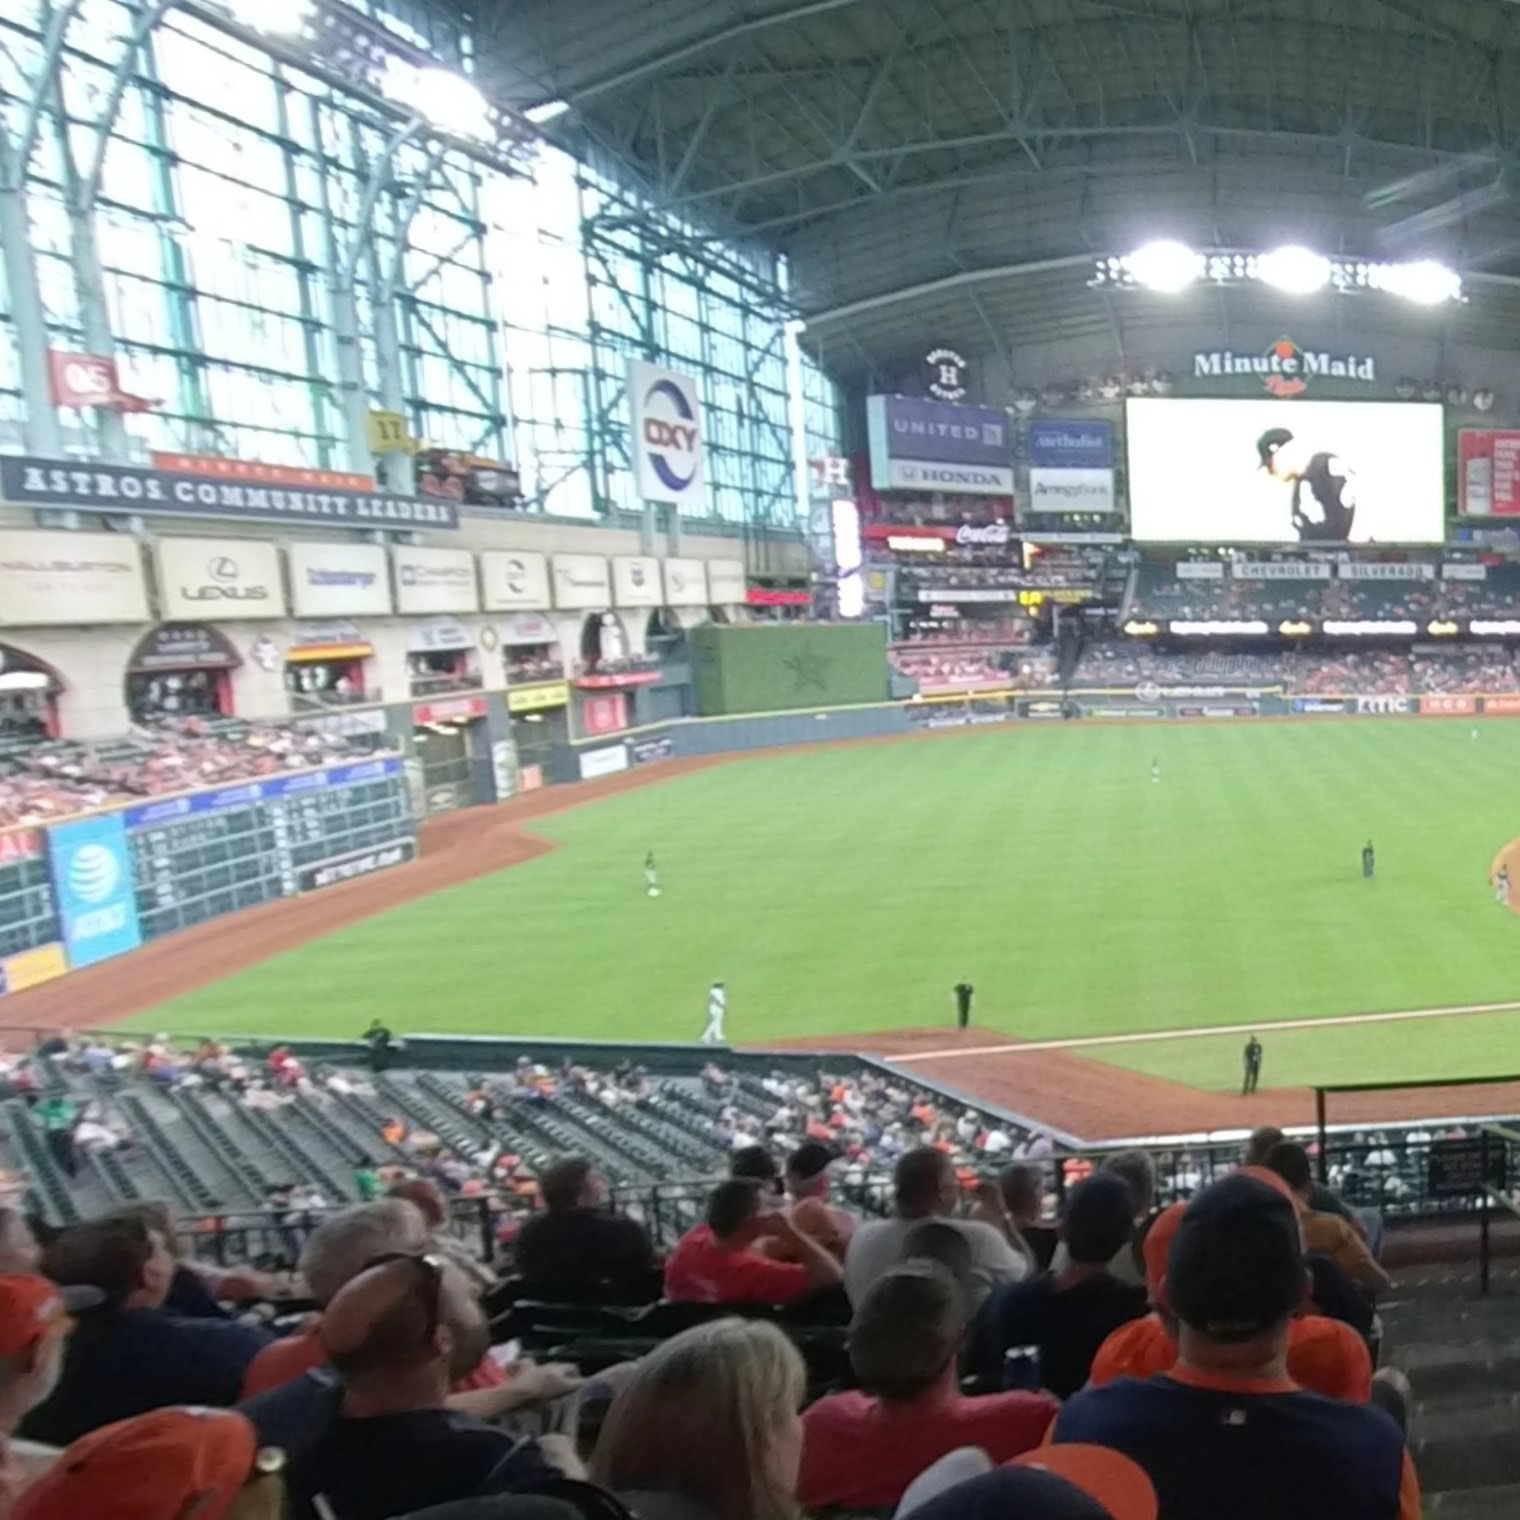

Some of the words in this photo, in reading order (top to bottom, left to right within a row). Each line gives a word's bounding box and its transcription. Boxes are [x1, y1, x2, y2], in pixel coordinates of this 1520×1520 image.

[1194, 352, 1298, 376] Minute
[1303, 352, 1375, 380] Maid
[643, 417, 698, 453] OXY
[893, 419, 978, 440] UNITED
[921, 468, 1003, 487] HONDA
[19, 466, 162, 498] ASTROS
[173, 481, 348, 517] COMMUNITY
[355, 497, 449, 522] LEADERS
[1242, 566, 1320, 577] CHEVROLET
[1350, 566, 1423, 577] SILVERADO
[180, 585, 269, 601] LEXUS
